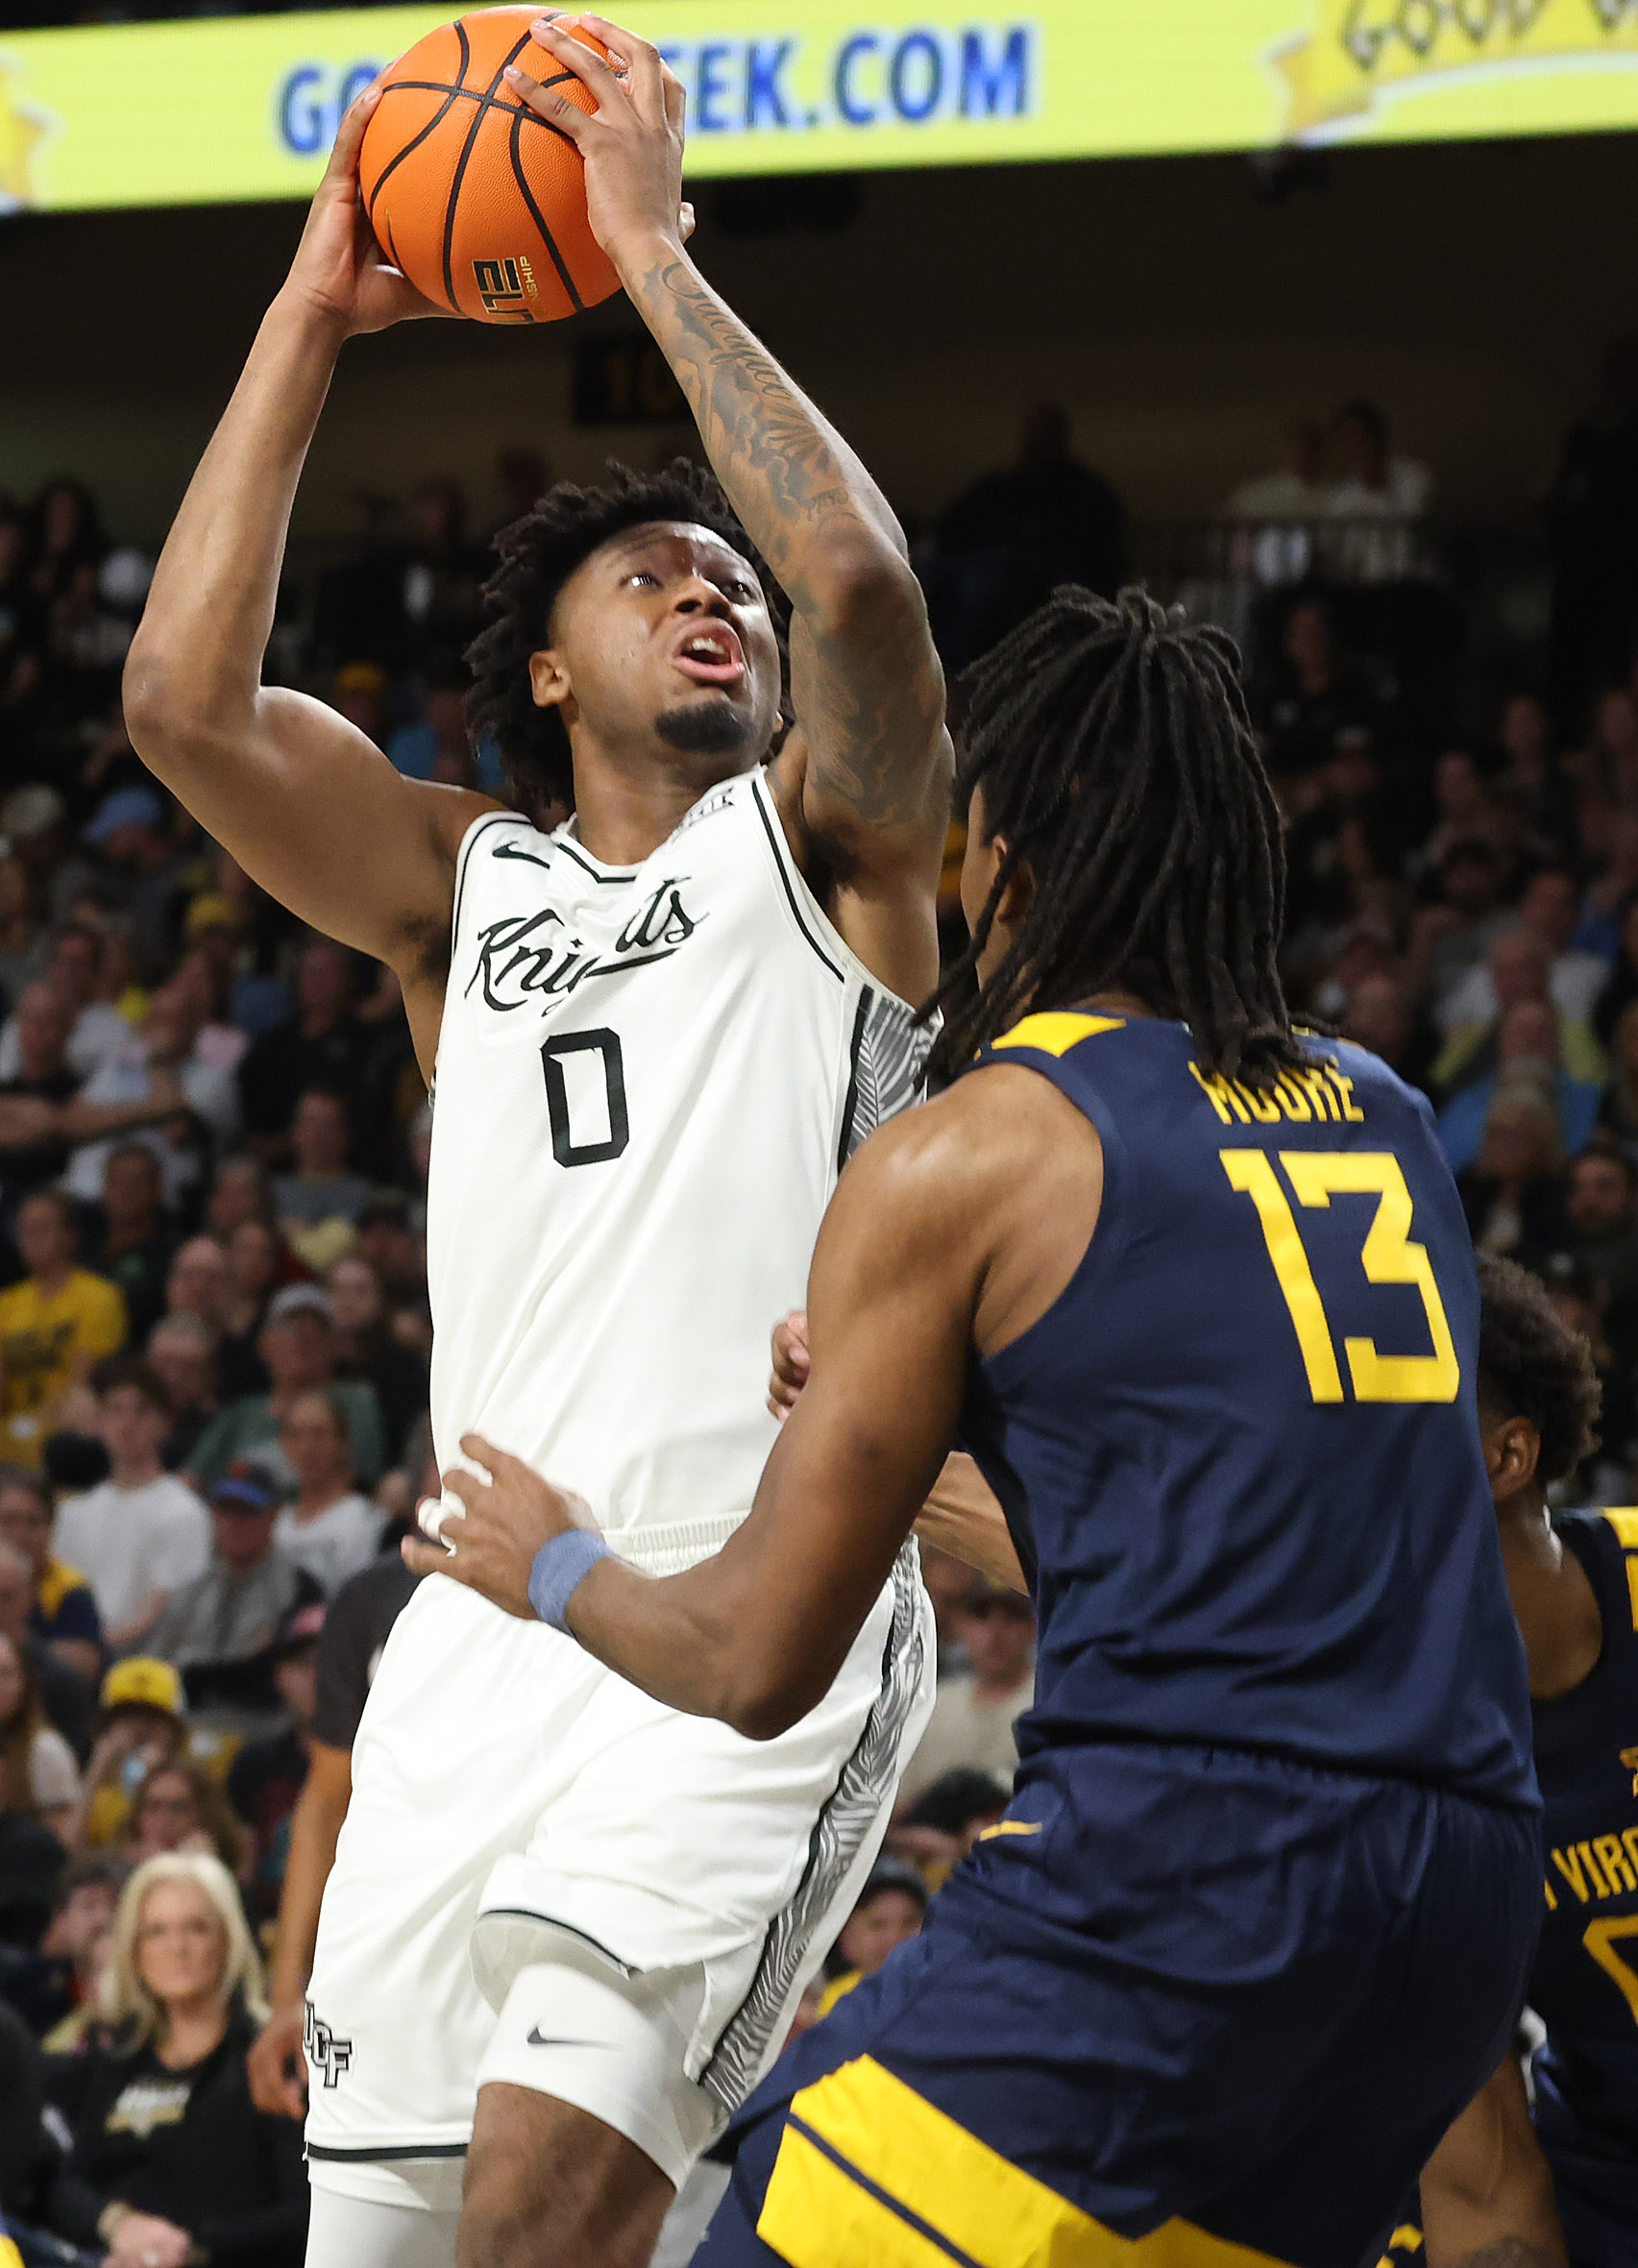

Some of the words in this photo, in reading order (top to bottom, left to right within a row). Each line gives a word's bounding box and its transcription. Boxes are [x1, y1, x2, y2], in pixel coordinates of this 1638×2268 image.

[465, 876, 709, 1016] Knits
[540, 1027, 629, 1169] 0
[1219, 1148, 1460, 1403] 13
